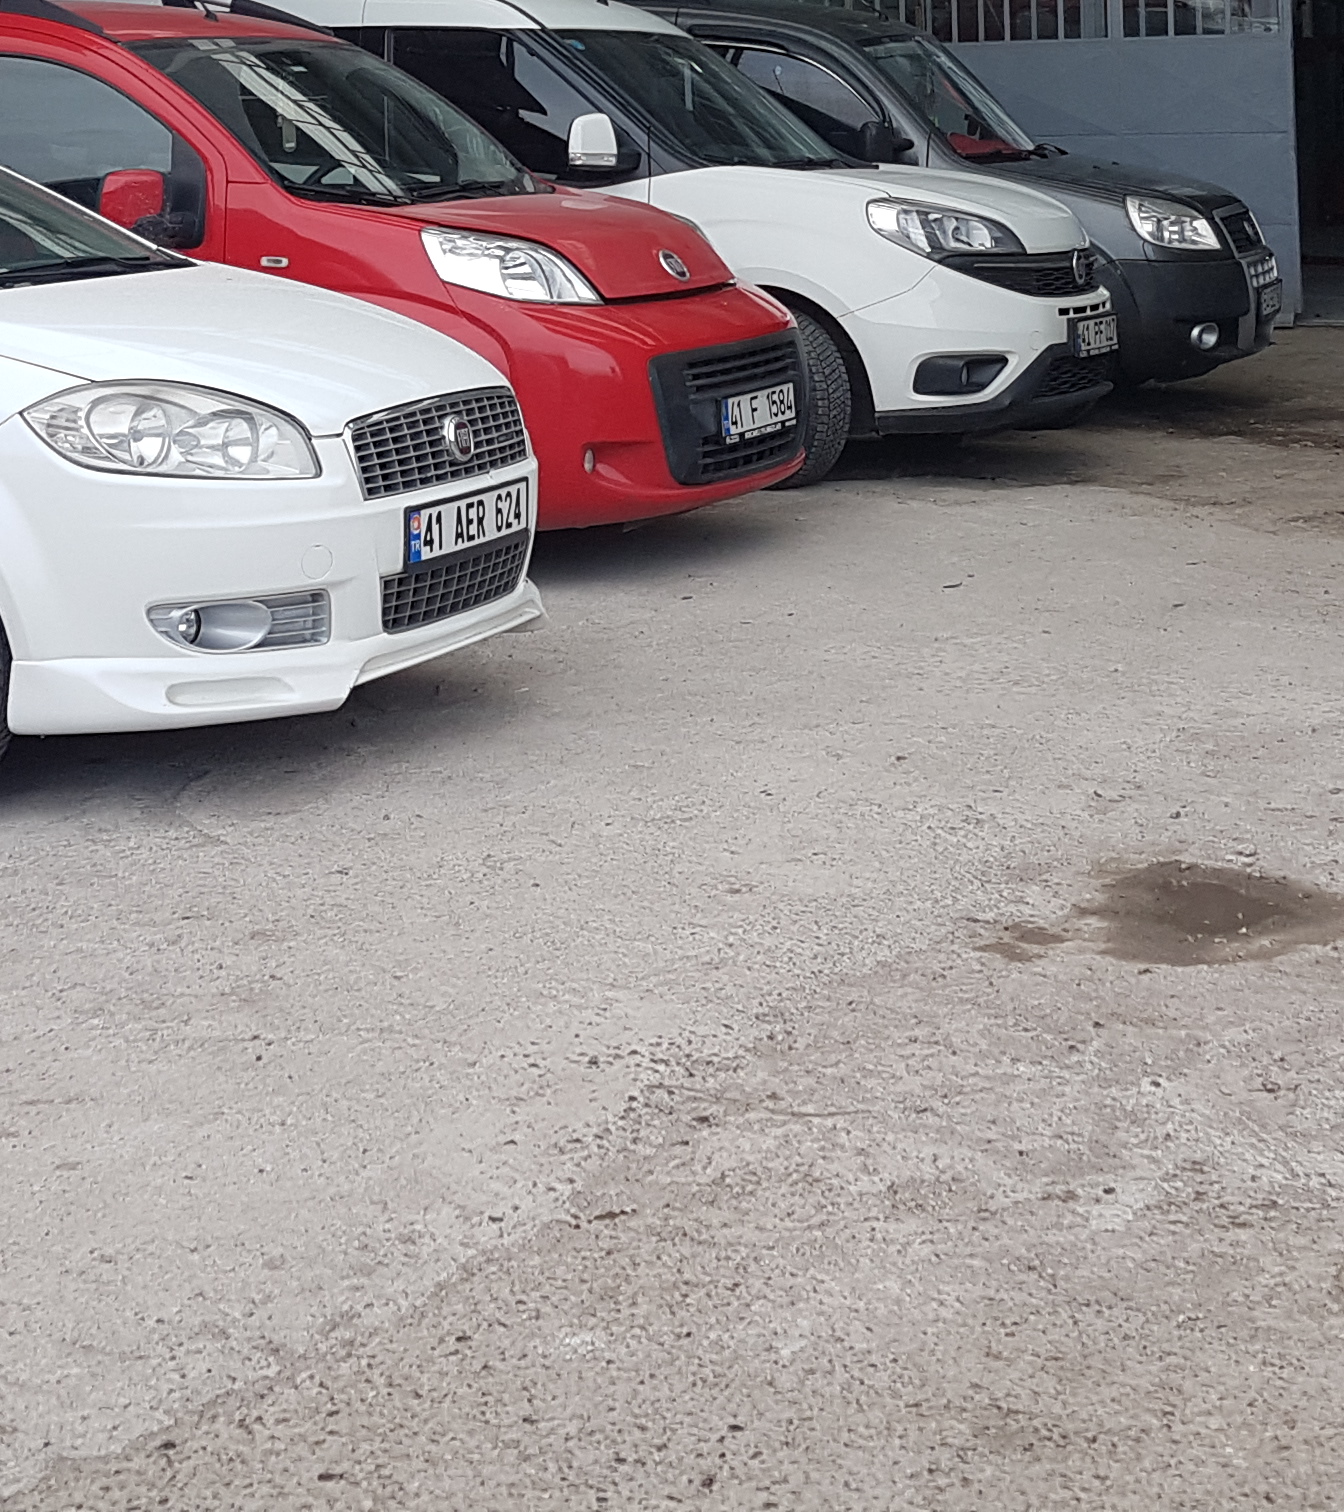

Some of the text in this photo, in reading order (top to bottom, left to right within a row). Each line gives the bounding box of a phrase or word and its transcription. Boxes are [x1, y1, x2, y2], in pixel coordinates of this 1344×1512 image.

[731, 386, 793, 430] 41 F 1584
[423, 487, 522, 553] 41 AER 624
